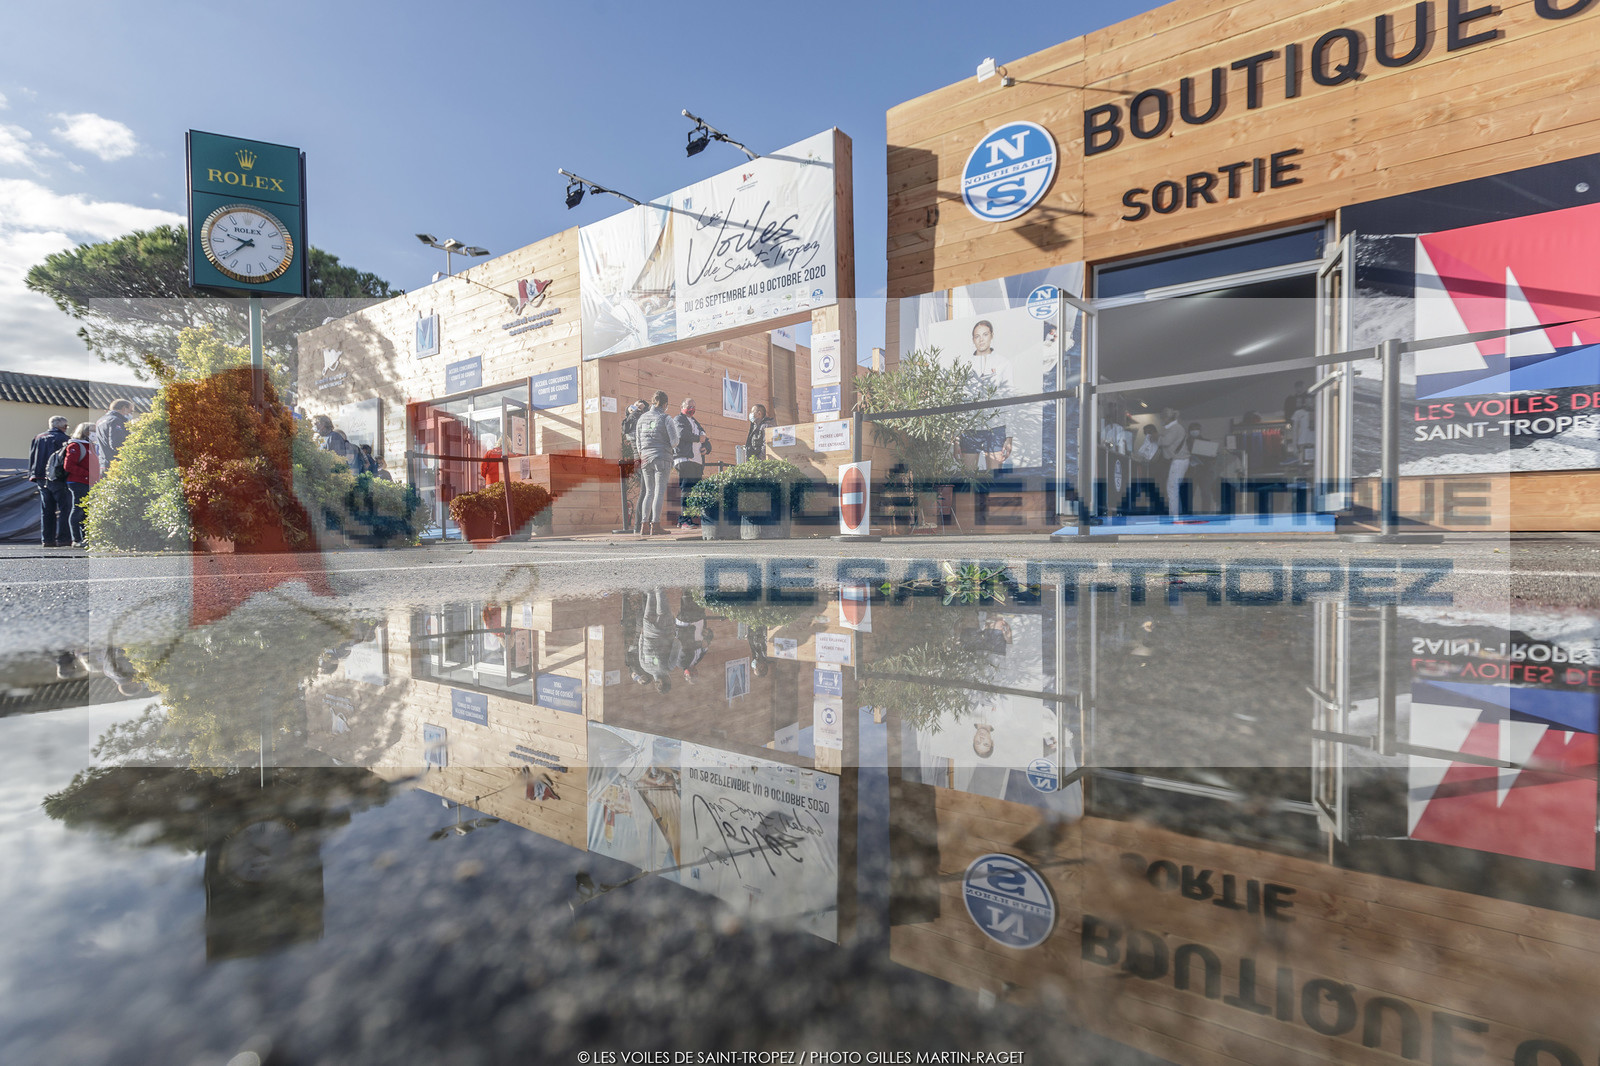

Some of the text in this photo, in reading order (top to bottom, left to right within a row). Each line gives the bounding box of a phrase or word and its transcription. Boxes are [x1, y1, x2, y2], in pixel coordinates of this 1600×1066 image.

[1084, 0, 1499, 156] BOUTIQUE
[985, 130, 1031, 168] N
[207, 168, 285, 192] ROLEX
[965, 156, 1053, 185] NORTH SAILS
[1122, 148, 1302, 221] SORTIE
[986, 176, 1027, 211] S
[234, 227, 262, 236] ROLEX
[696, 206, 723, 231] Les
[687, 197, 799, 286] Voiles
[703, 259, 721, 277] de
[684, 301, 694, 313] DU
[695, 299, 705, 311] 26
[705, 289, 747, 307] SEPTEMBRE
[748, 286, 758, 297] AU
[759, 284, 765, 293] 9
[766, 272, 802, 292] OCTOBRE
[804, 264, 826, 283] 2020
[1413, 392, 1600, 421] LES VOILES DE
